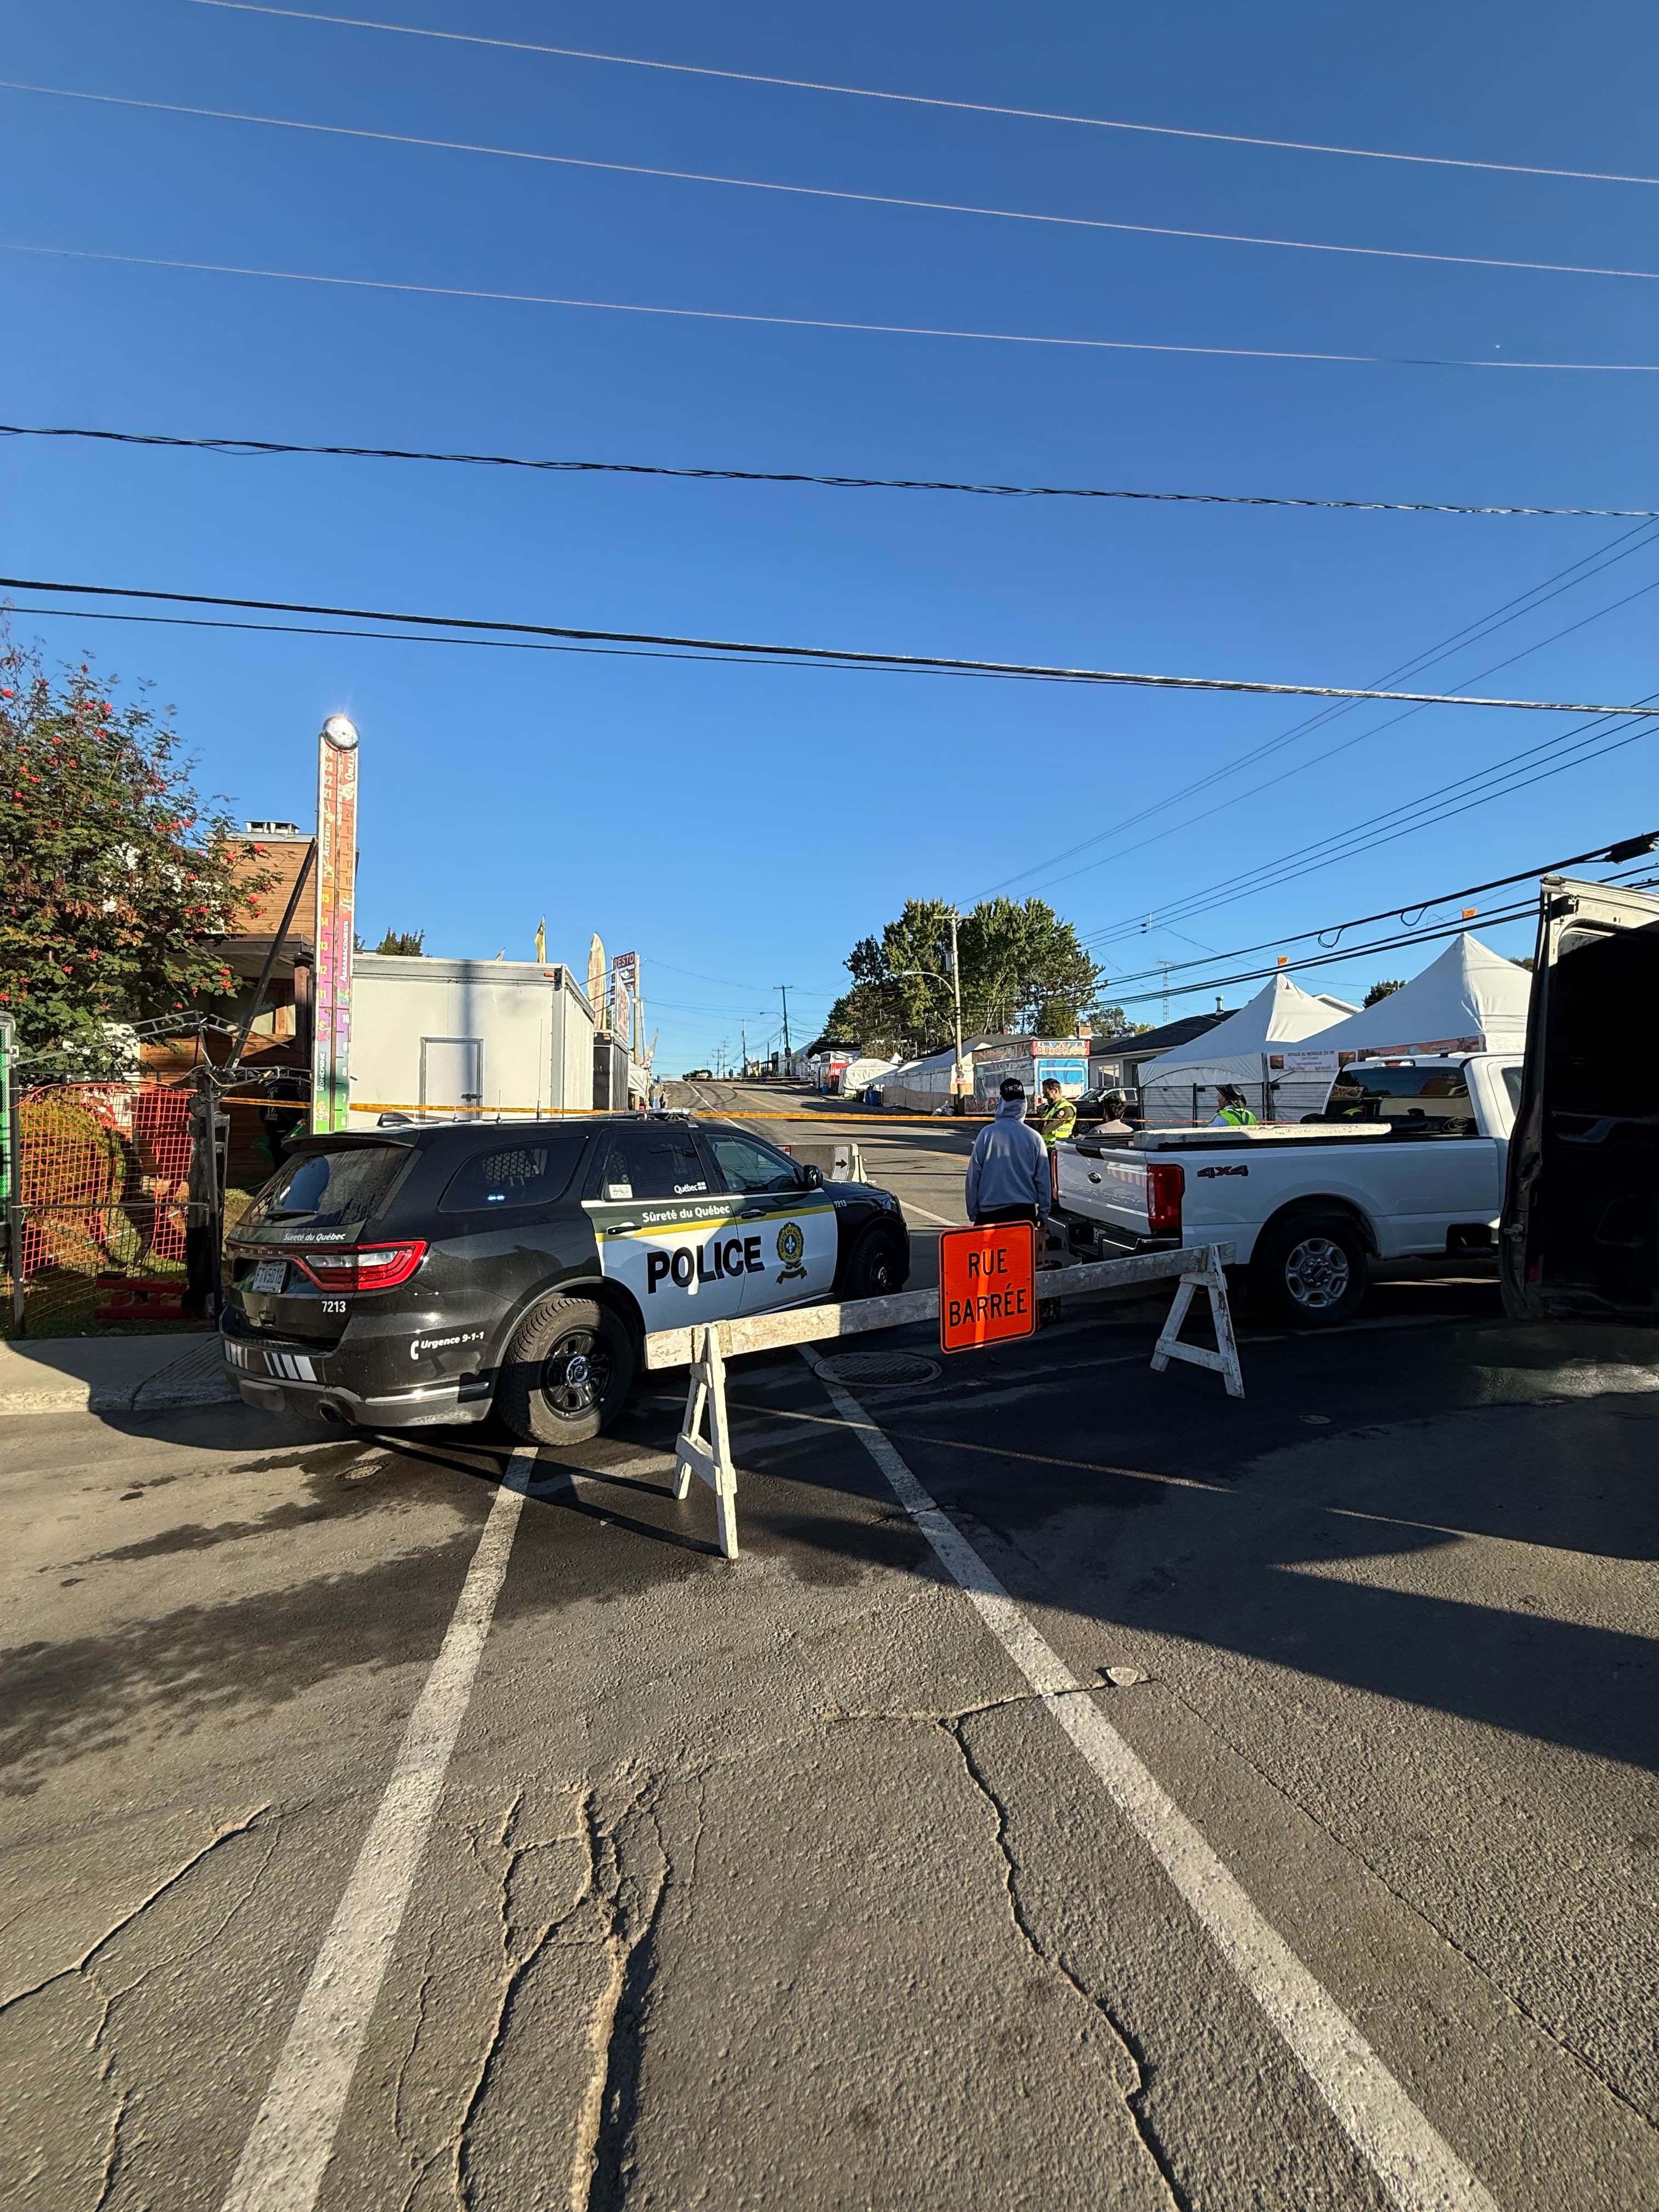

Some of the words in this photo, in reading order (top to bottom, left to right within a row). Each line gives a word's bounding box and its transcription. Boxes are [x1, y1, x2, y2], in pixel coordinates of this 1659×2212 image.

[324, 788, 332, 799] 21
[321, 893, 330, 903] 15
[320, 917, 329, 927] 14
[320, 941, 328, 951] 13
[614, 953, 634, 969] RESTO
[319, 965, 328, 975] 12
[319, 989, 327, 998] 11
[342, 1014, 349, 1024] 10
[343, 1042, 348, 1051] 9
[342, 1067, 347, 1076] 8
[342, 1093, 347, 1103] 7
[341, 1116, 346, 1126] 6
[674, 1183, 698, 1194] Québec
[833, 1200, 847, 1208] 7213
[642, 1209, 678, 1223] Sûreté
[680, 1208, 693, 1218] du
[695, 1205, 731, 1218] Québec
[316, 1232, 346, 1242] Québec
[647, 1235, 765, 1294] POLICE
[968, 1248, 1008, 1279] RUE
[321, 1301, 346, 1313] 7213
[949, 1283, 1028, 1327] BARRÉE
[421, 1336, 460, 1348] Urgence
[462, 1331, 484, 1342] 9-1-1
